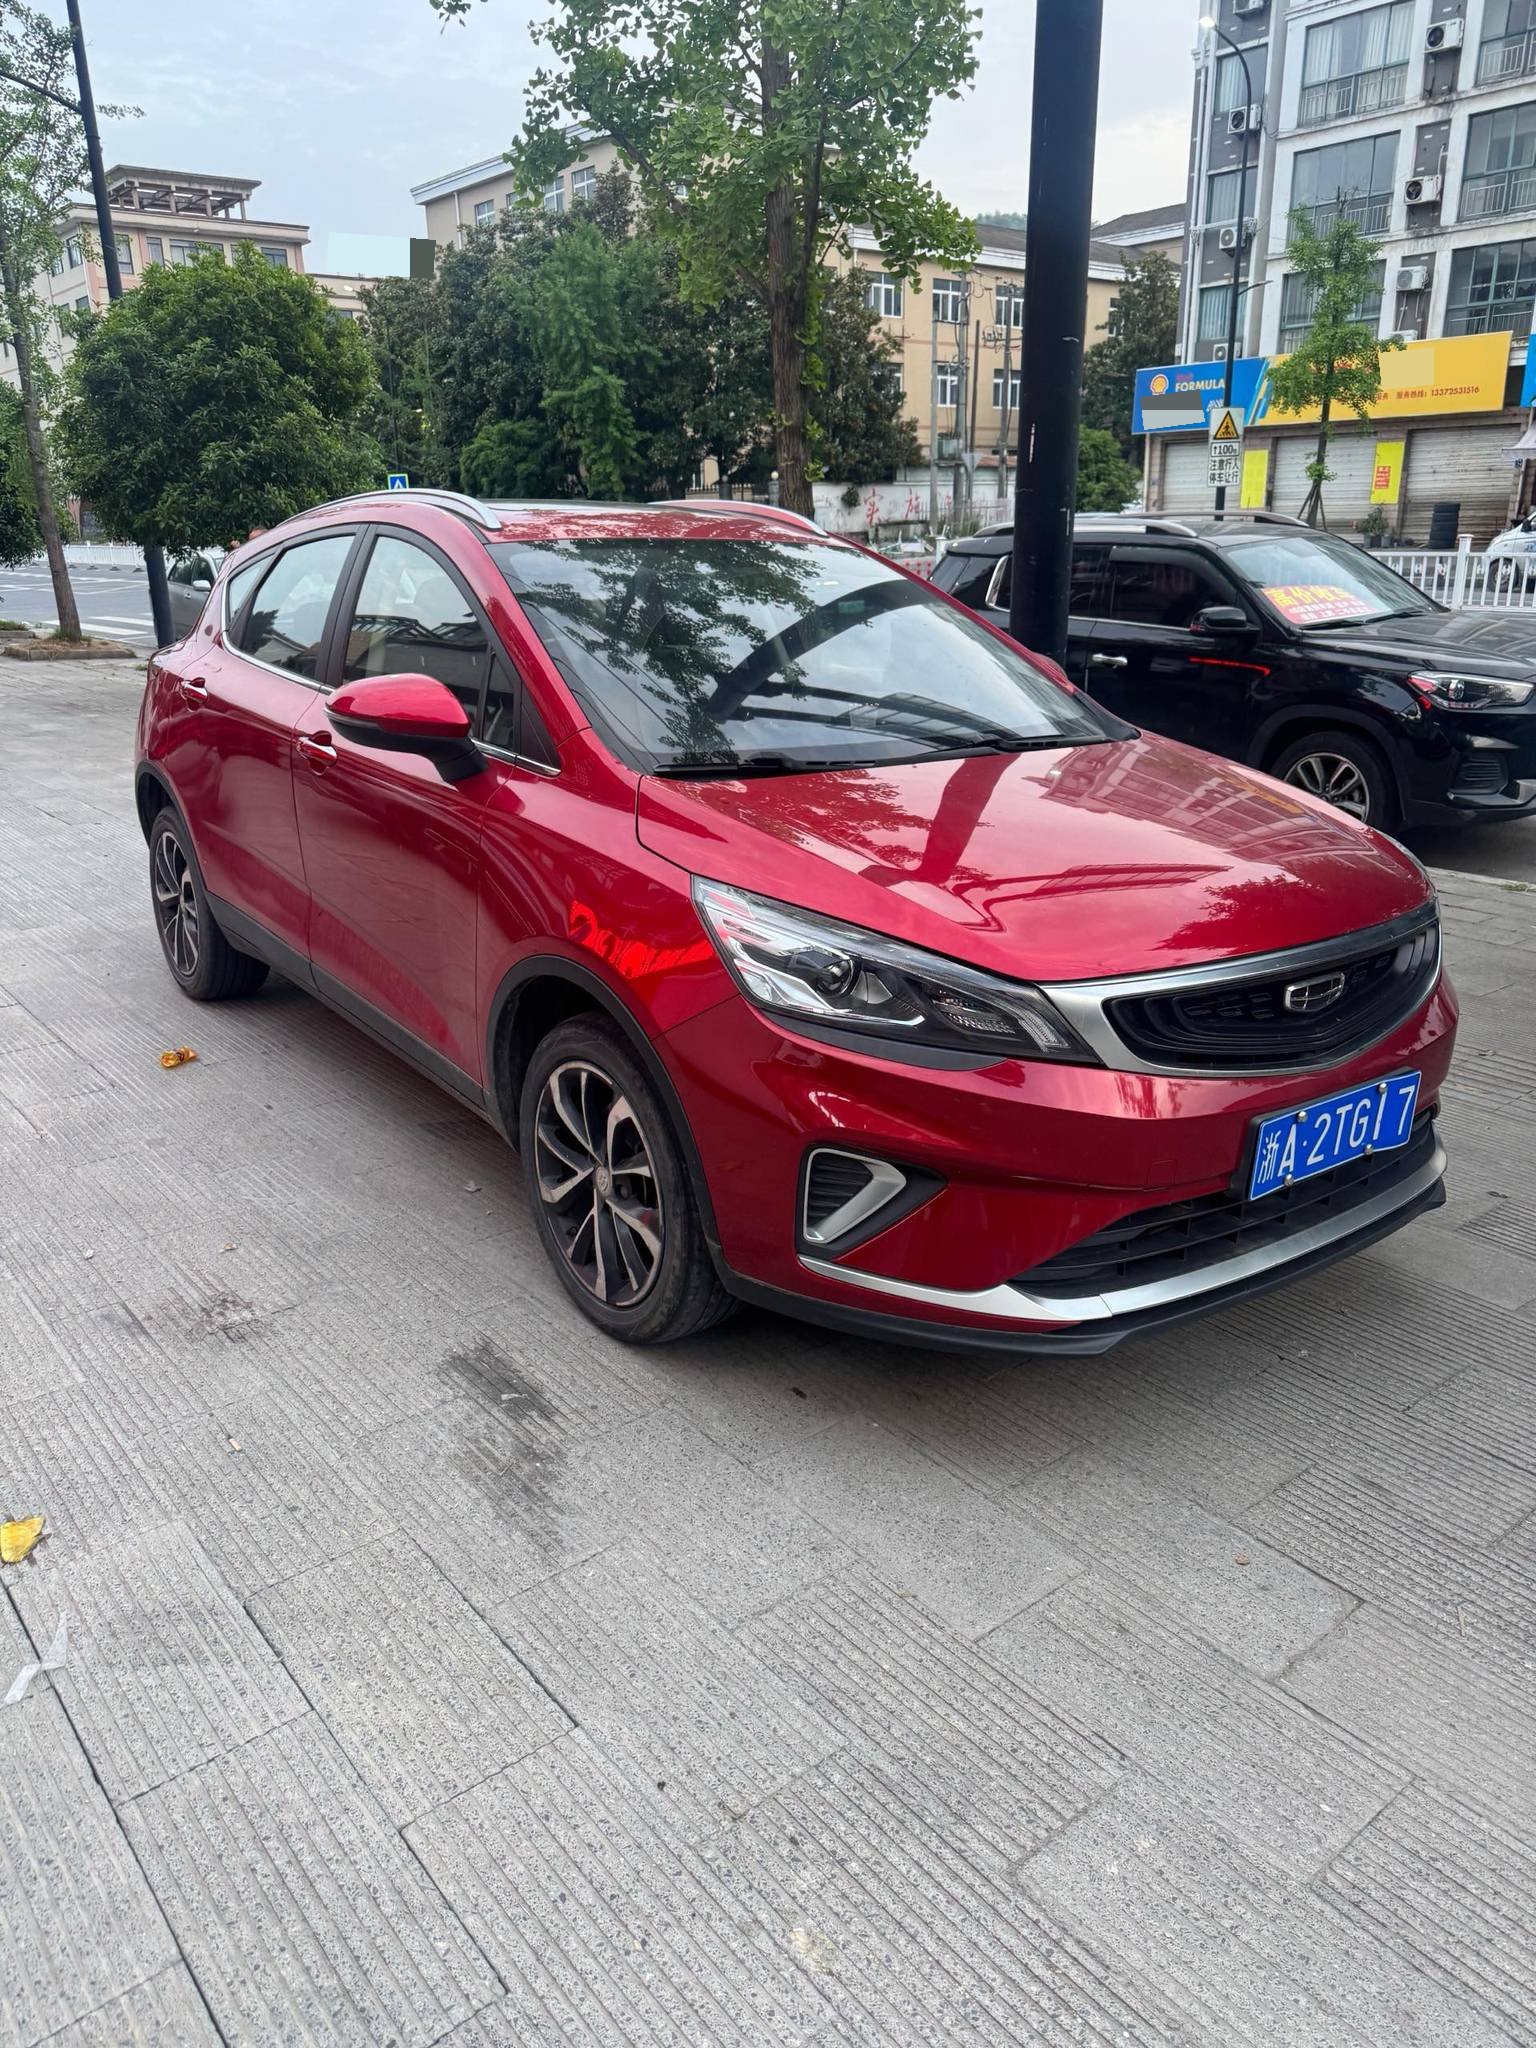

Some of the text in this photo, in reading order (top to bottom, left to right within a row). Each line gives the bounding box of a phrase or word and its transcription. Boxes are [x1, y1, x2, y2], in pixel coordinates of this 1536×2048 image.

[1175, 378, 1225, 392] FORMULA
[1209, 458, 1239, 471] 注意行人
[1208, 471, 1239, 484] 停车让行
